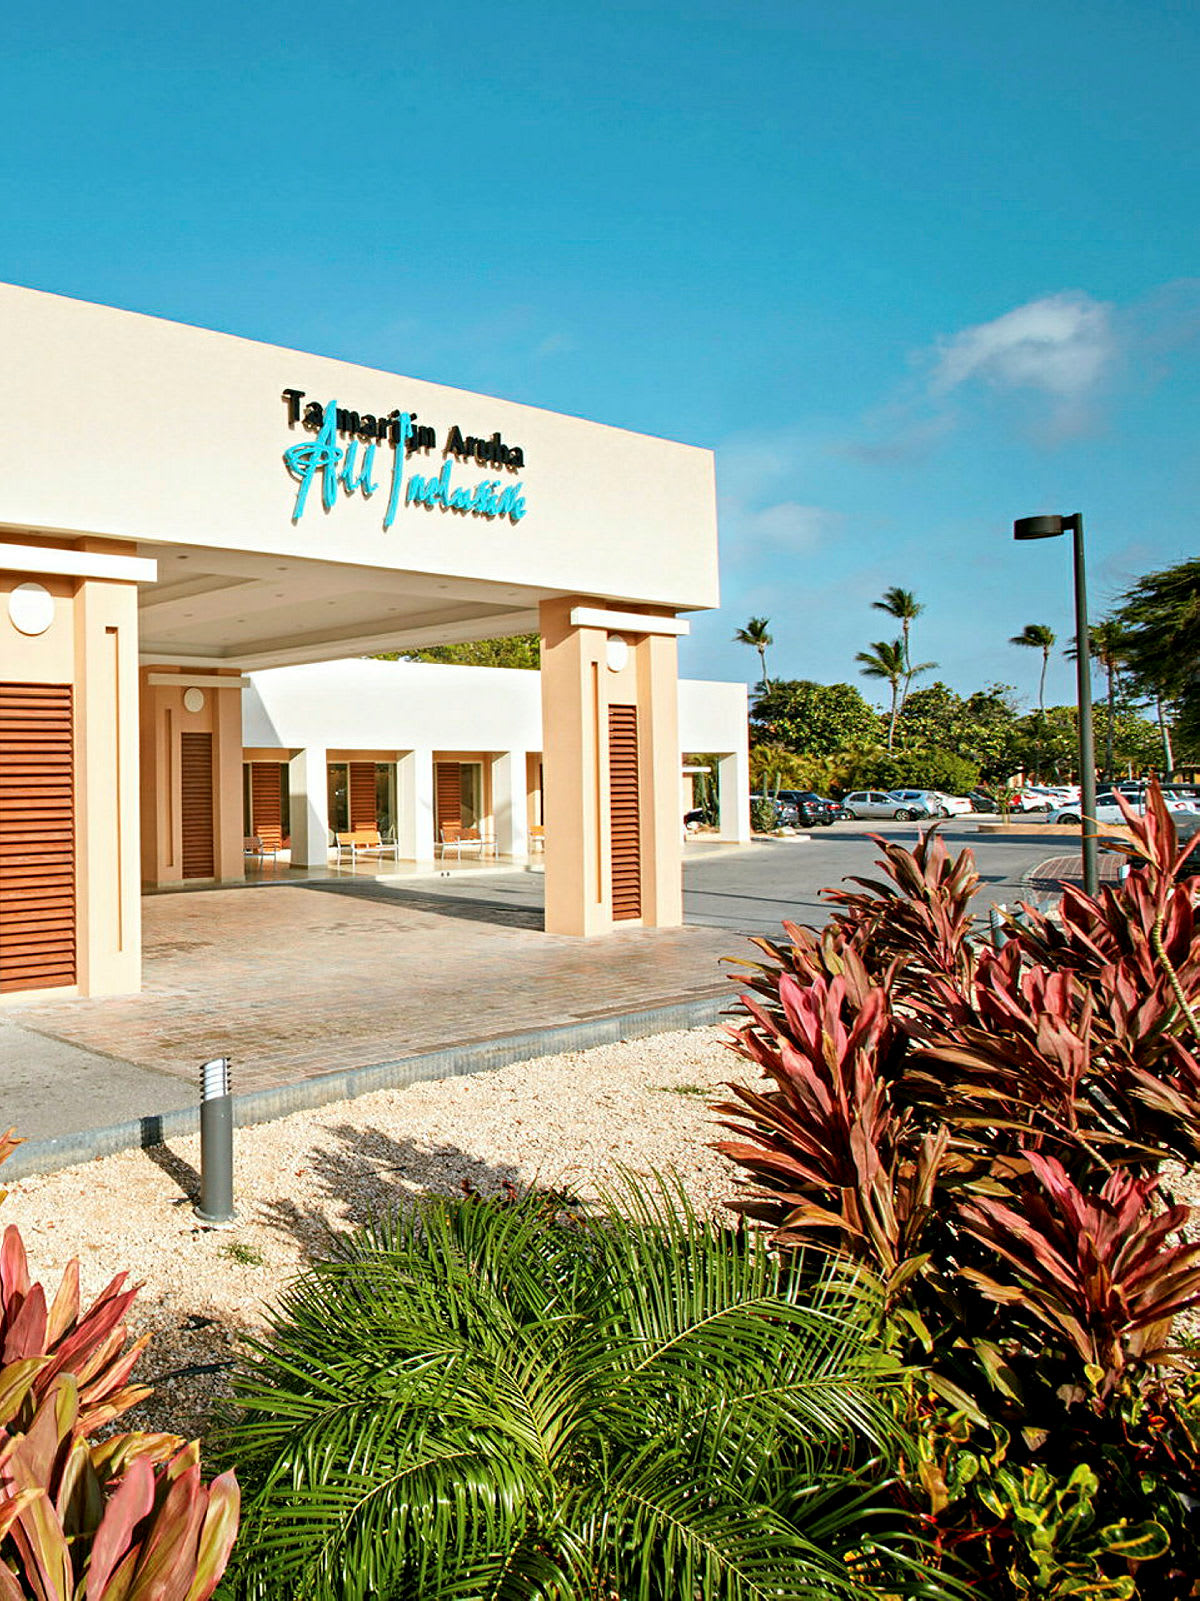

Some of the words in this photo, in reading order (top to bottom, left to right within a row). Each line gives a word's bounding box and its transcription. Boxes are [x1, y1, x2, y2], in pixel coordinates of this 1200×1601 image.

[284, 400, 379, 519] All
[384, 411, 528, 527] Inclusive
[446, 425, 525, 468] Aruba
